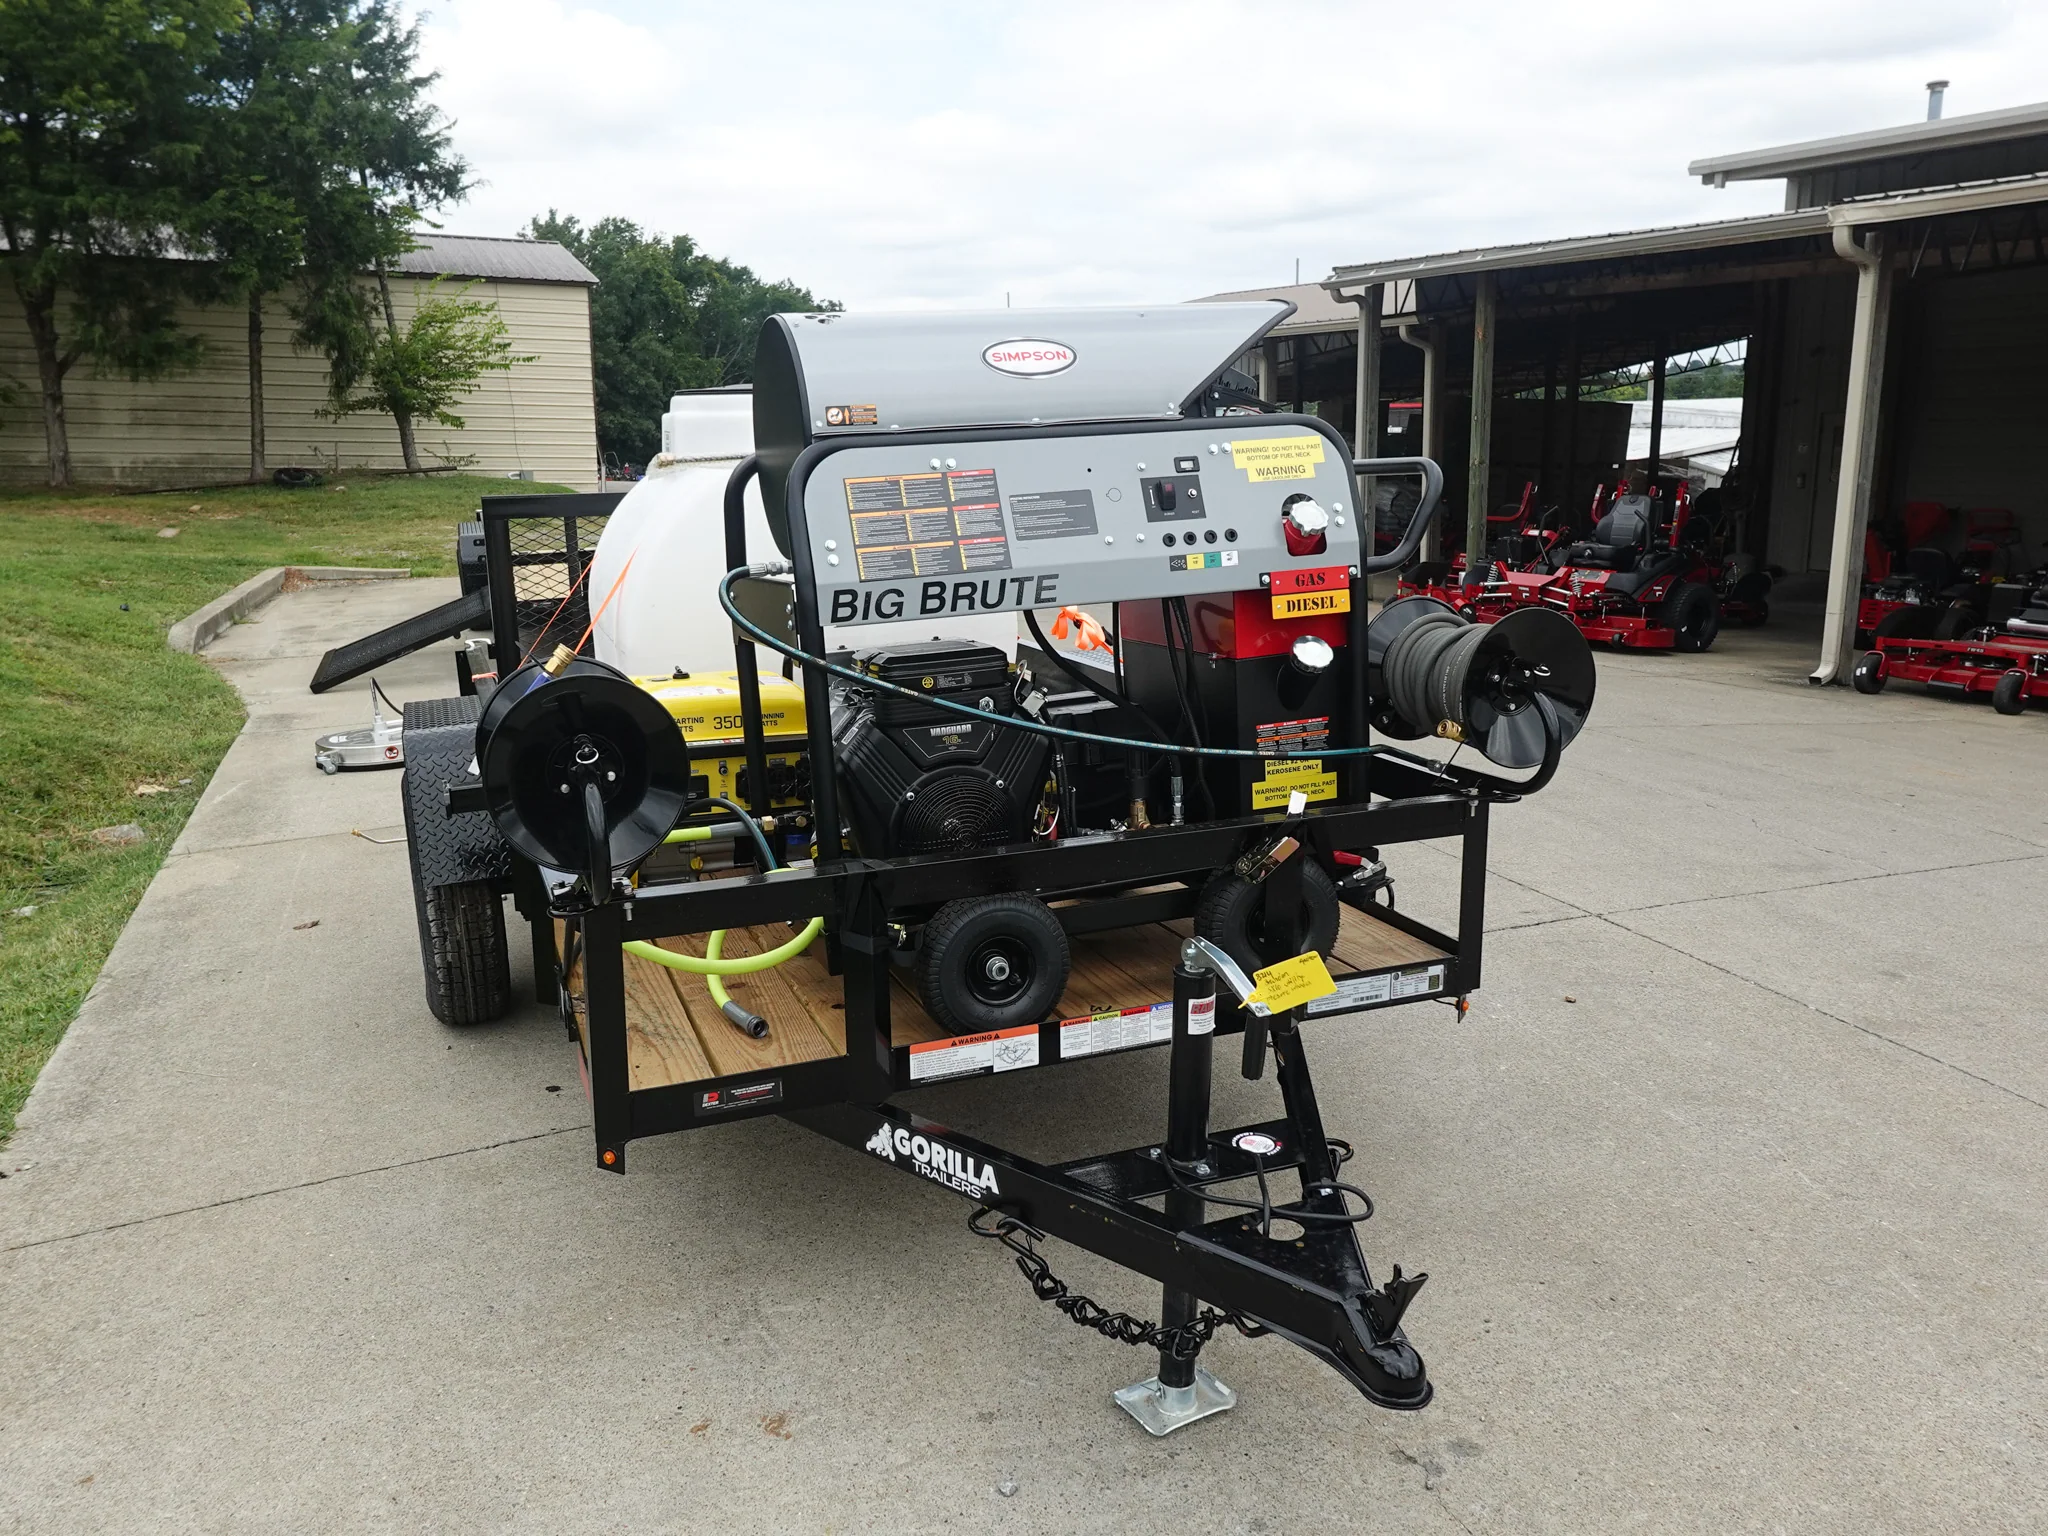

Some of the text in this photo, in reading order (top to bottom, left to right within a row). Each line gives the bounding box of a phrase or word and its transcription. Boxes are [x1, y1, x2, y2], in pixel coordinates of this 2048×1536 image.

[992, 350, 1068, 363] SIMPSON
[1234, 446, 1269, 455] WARNING!
[1256, 464, 1306, 477] WARNING
[1295, 572, 1326, 588] GAS
[830, 573, 1060, 624] BIG BRUTE
[1286, 595, 1338, 613] DIESEL
[713, 715, 743, 730] 350
[930, 724, 972, 737] VANGUARD
[1266, 760, 1289, 768] DIESEL
[1266, 763, 1320, 776] KEROSENE ONLY
[1254, 785, 1288, 796] WARNING!
[1321, 779, 1336, 787] PAST
[1264, 794, 1287, 802] BOTTOM
[957, 1034, 993, 1045] WARNING
[893, 1128, 1000, 1195] GORILLA
[911, 1158, 981, 1199] TRAILERS
